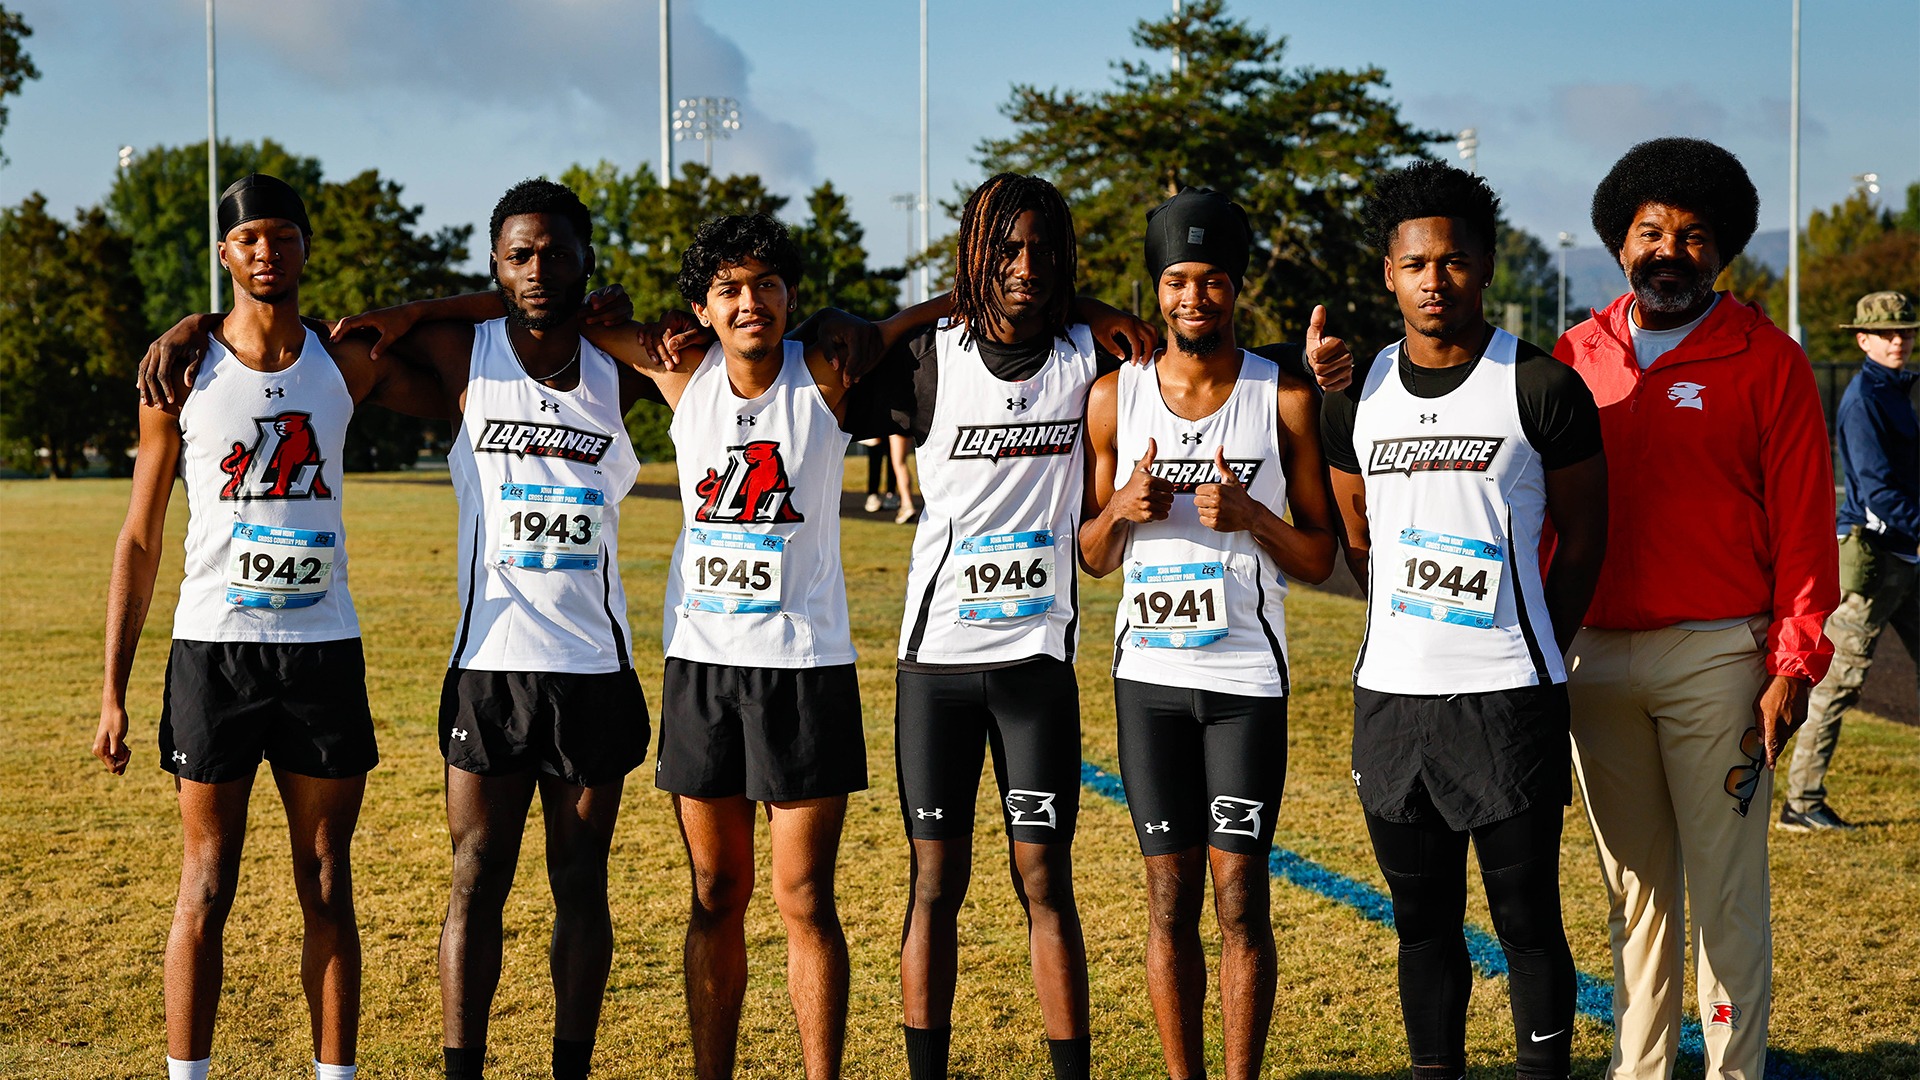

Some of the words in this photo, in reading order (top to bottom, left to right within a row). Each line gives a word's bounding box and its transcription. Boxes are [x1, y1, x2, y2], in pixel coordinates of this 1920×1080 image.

[480, 423, 608, 455] LAGRANGE
[525, 445, 597, 463] COLLEGE
[954, 422, 1079, 457] LAGRANGE
[999, 445, 1069, 457] COLLEGE
[1370, 439, 1498, 472] LAGRANGE
[1412, 461, 1486, 471] COLLEGE
[510, 487, 523, 496] CCS
[510, 511, 591, 545] 1943
[762, 538, 776, 546] CCS
[1483, 546, 1497, 555] CCS
[239, 552, 322, 584] 1942
[696, 556, 771, 591] 1945
[964, 558, 1047, 594] 1946
[1405, 557, 1488, 601] 1944
[1134, 588, 1215, 624] 1941
